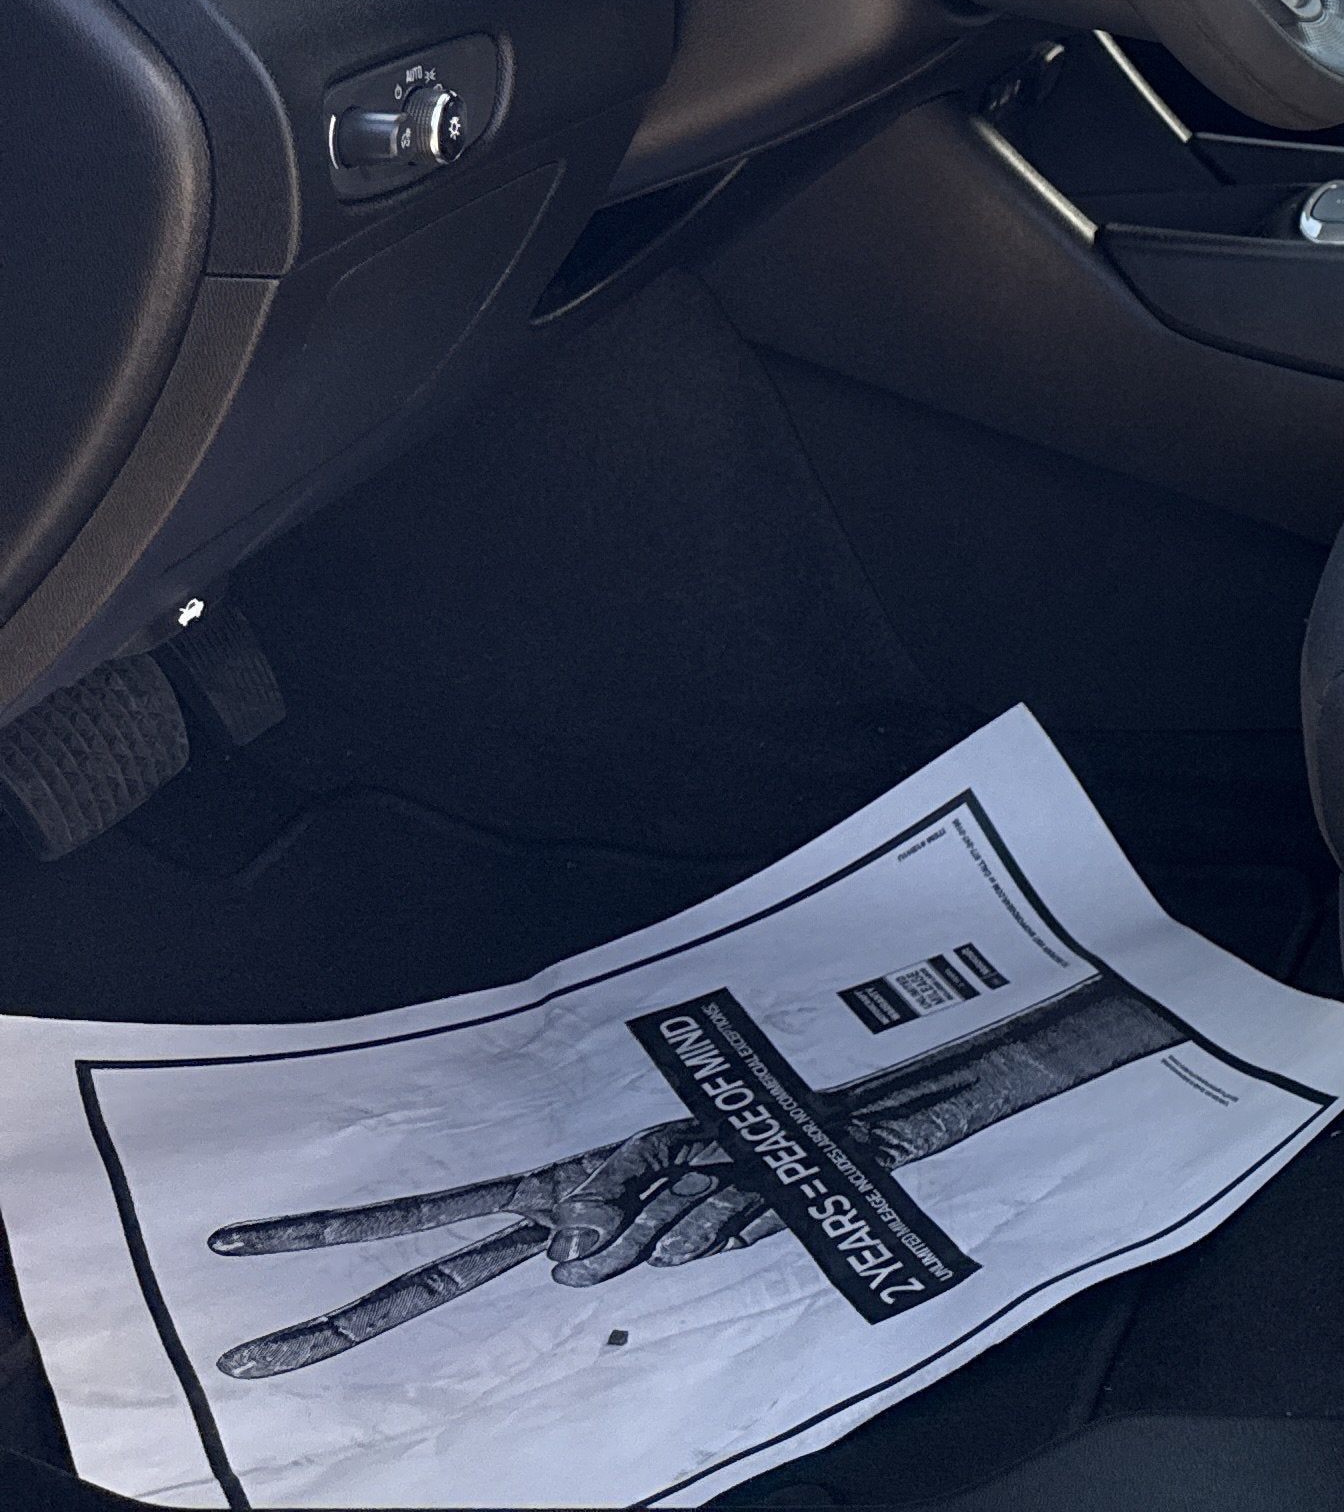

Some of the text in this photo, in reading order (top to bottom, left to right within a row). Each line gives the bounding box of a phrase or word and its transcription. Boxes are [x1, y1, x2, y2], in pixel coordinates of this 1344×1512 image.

[405, 65, 423, 83] AUTO
[905, 970, 945, 1005] MILEAGE
[656, 1010, 731, 1080] MIND
[702, 1071, 757, 1114] OF
[744, 1052, 797, 1110] COMMERCIAL
[787, 1105, 810, 1124] NO
[728, 1101, 821, 1185] PEACE
[825, 1147, 873, 1193] INCLUDES
[806, 1191, 905, 1290] YEARS
[900, 1230, 954, 1281] UNLIMITED
[878, 1274, 925, 1304] 2
